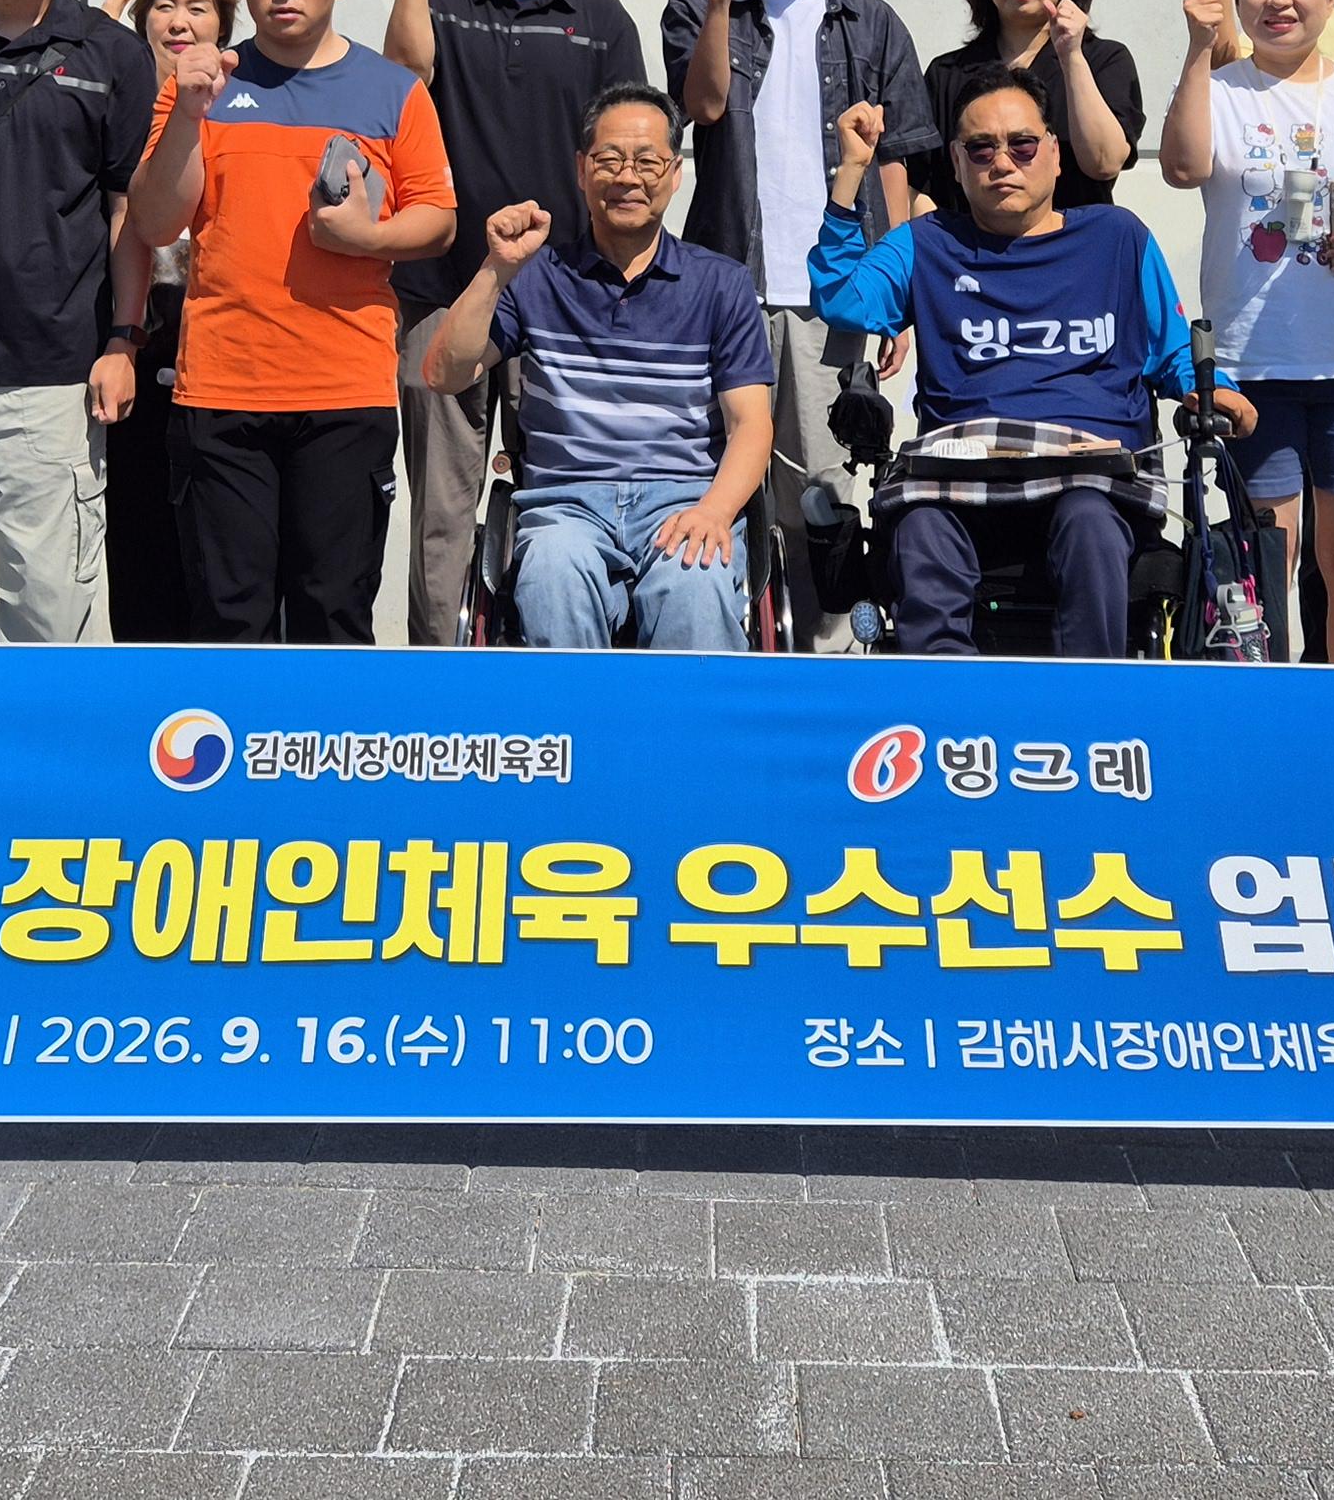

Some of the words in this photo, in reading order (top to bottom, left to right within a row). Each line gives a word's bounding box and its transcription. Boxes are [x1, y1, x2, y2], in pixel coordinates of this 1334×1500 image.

[960, 311, 1116, 361] 빙그레
[244, 733, 571, 781] 김해시장애인체육회
[939, 738, 1150, 798] 빙그레
[669, 842, 1184, 972] 우수선수
[34, 1015, 203, 1065] 2026.
[219, 1015, 270, 1065] 9.
[296, 1013, 467, 1067] 16.(수)
[491, 1016, 654, 1065] 11:00
[803, 1017, 906, 1068] 장소
